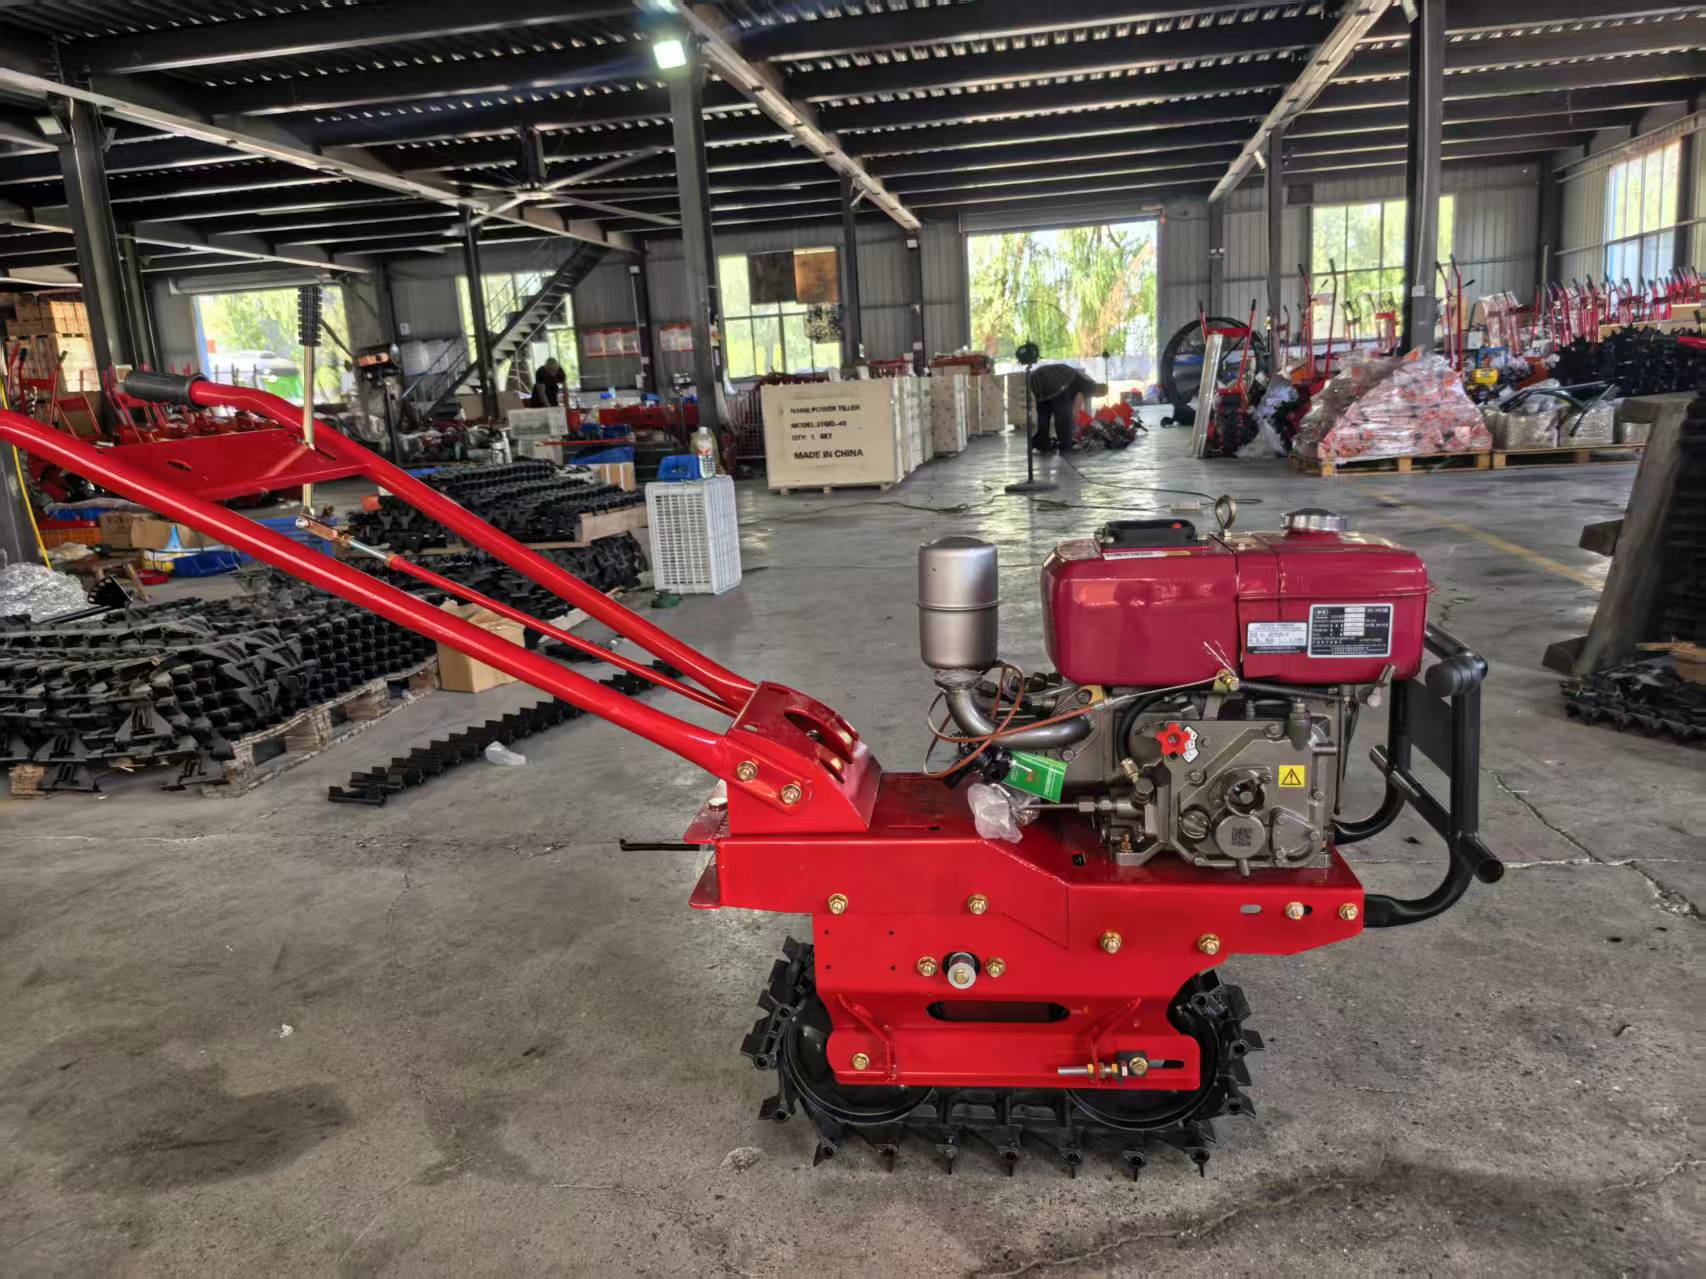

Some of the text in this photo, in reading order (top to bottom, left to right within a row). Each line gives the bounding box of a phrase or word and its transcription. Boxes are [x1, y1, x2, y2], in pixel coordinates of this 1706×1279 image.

[794, 448, 864, 459] MADE IN CHINA
